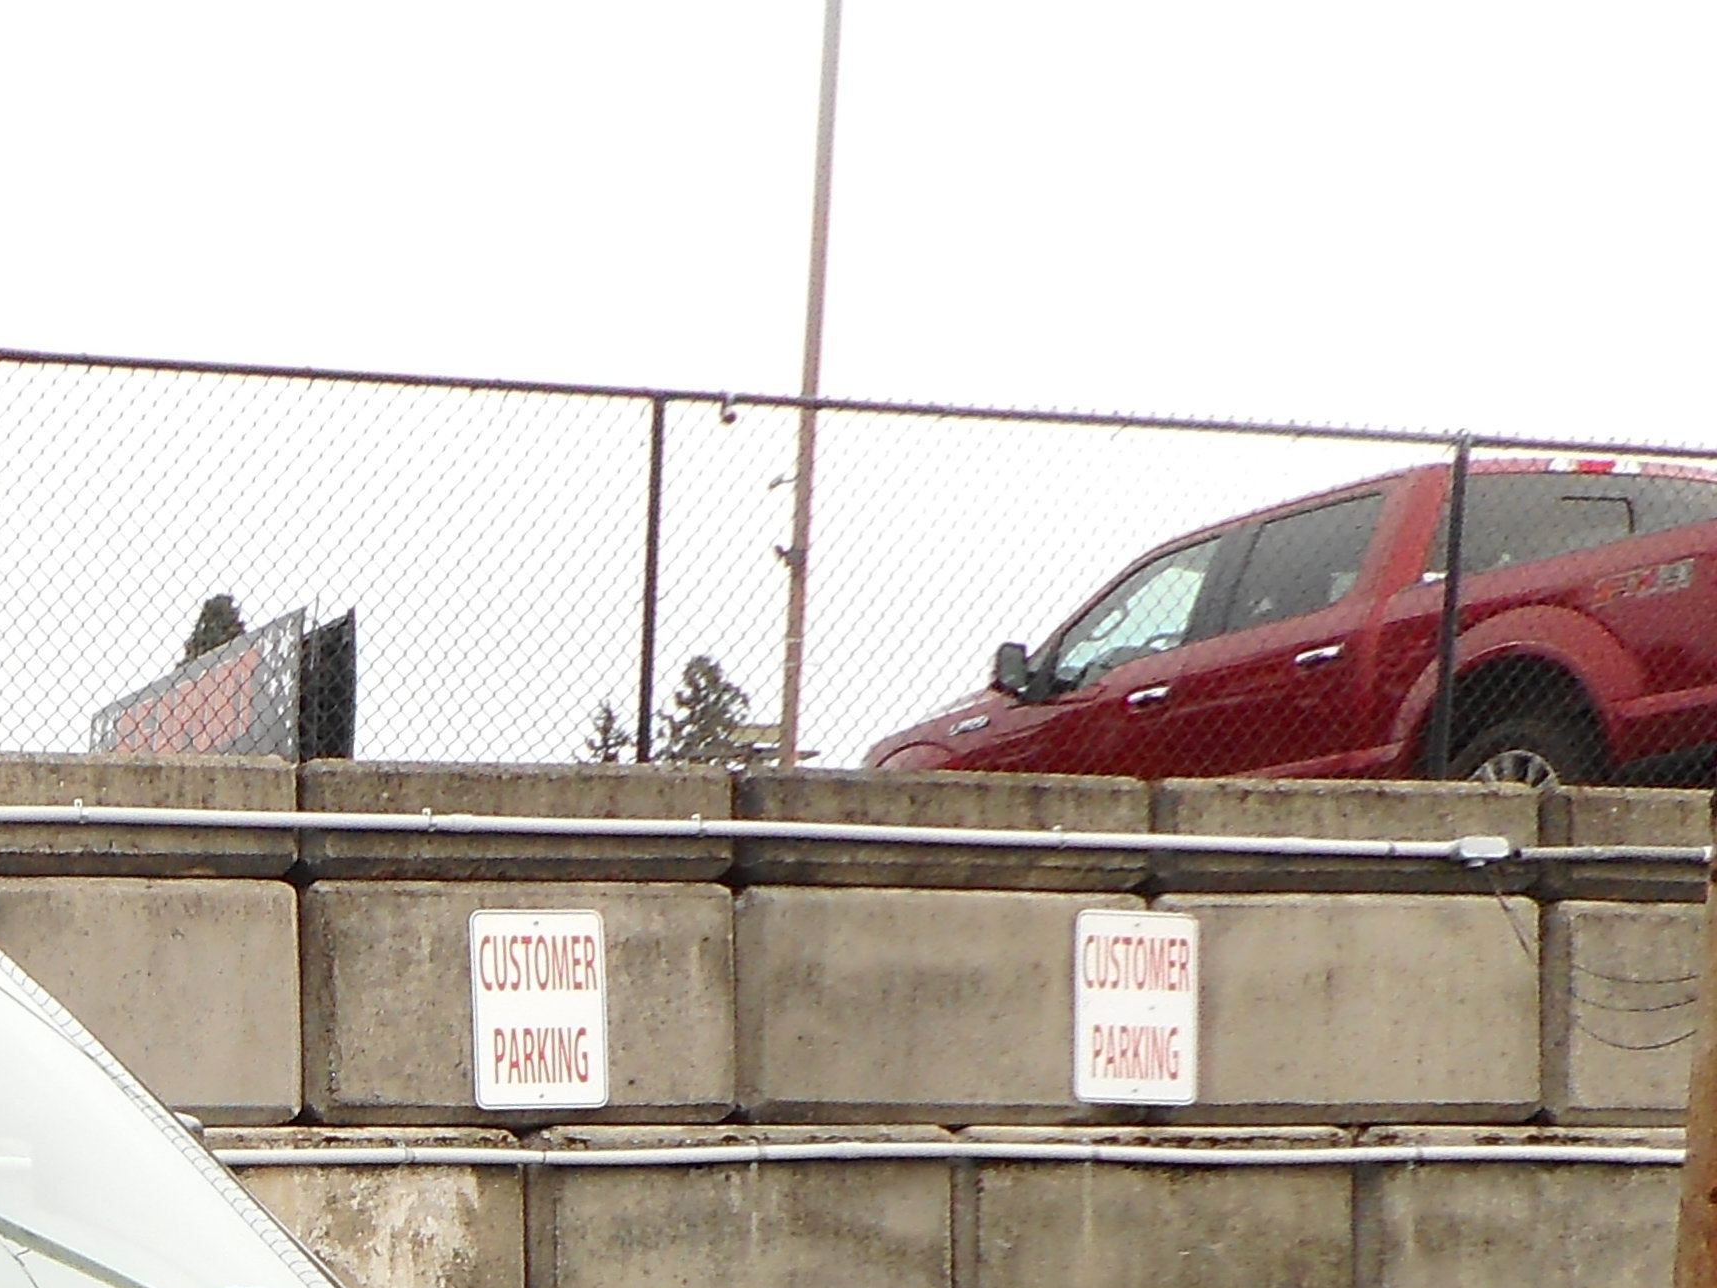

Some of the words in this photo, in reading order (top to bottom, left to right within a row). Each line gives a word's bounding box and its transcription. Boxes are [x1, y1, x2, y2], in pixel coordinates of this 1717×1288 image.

[479, 934, 598, 991] CUSTOMER
[1083, 934, 1190, 991] CUSTOMER
[493, 1026, 589, 1084] PARKING
[1091, 1024, 1179, 1080] PARKING
